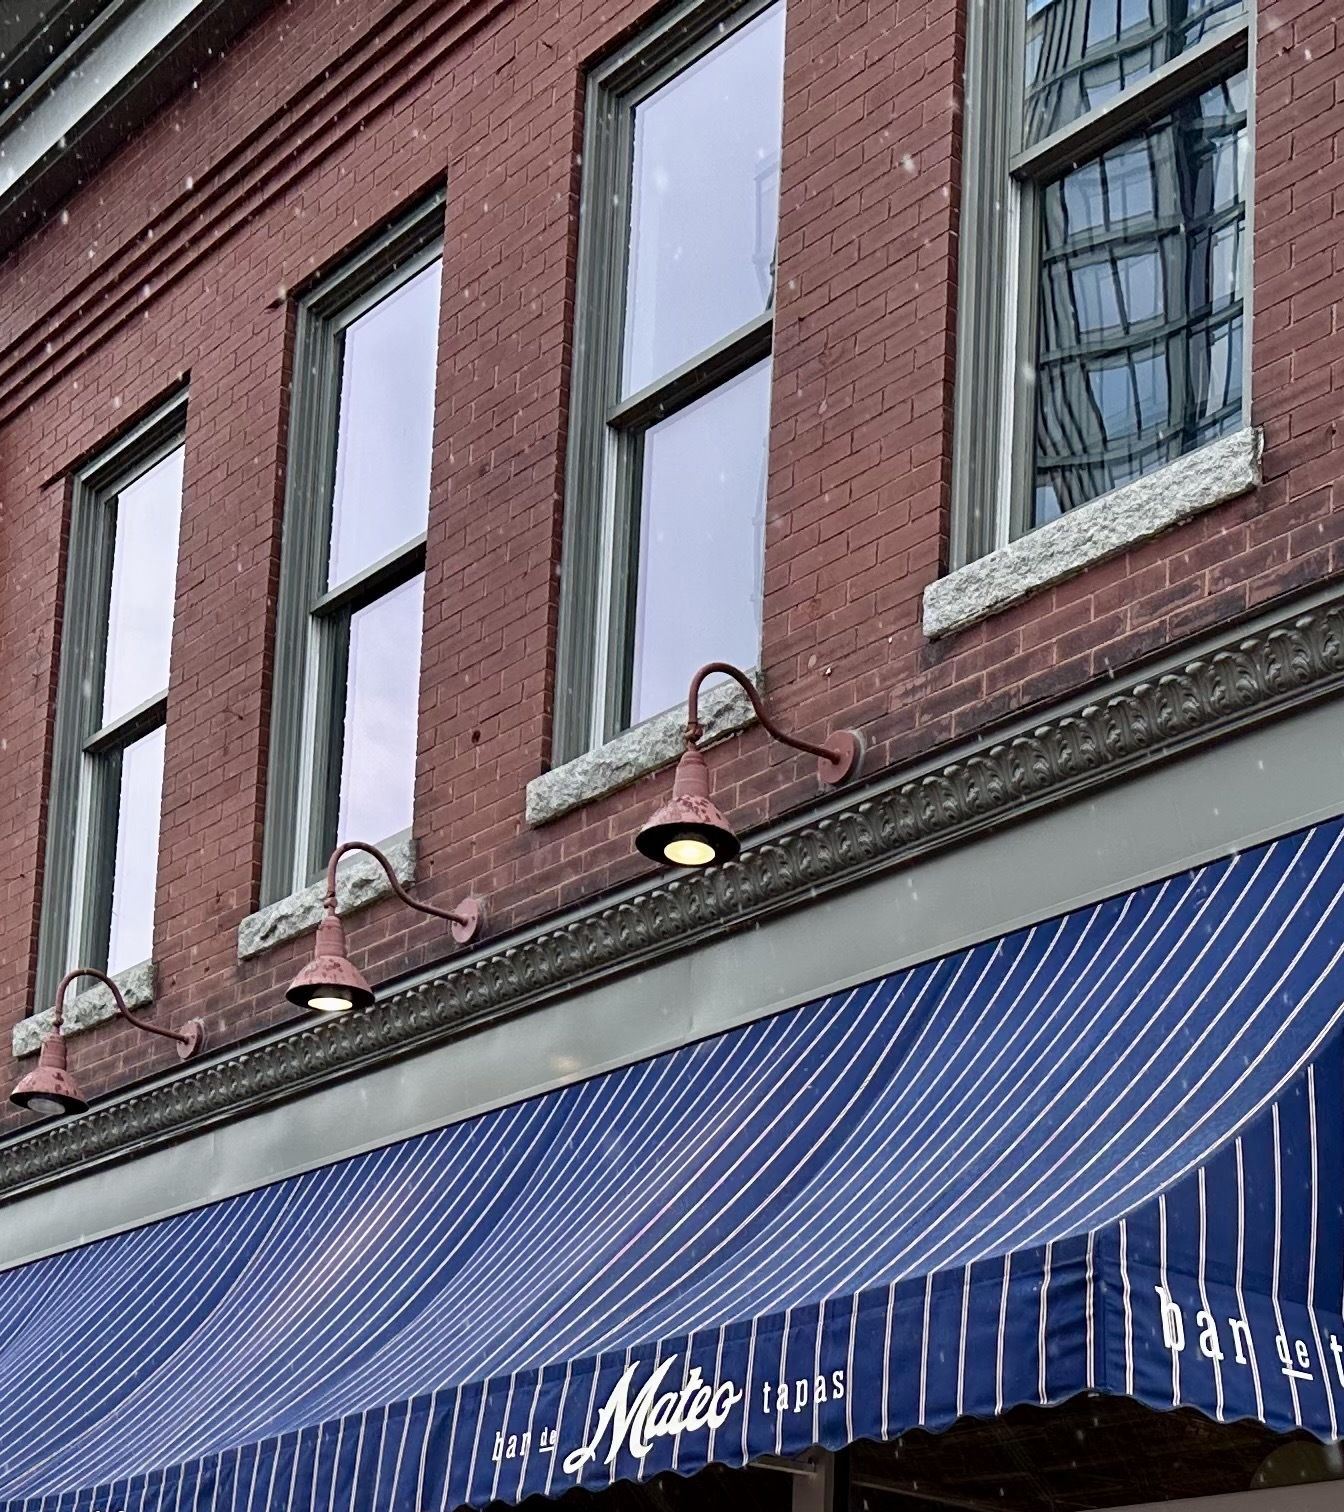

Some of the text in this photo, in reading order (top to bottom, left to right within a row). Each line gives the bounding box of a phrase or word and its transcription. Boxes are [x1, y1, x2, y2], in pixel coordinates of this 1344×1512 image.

[1154, 1285, 1250, 1364] bar
[1274, 1333, 1313, 1381] de
[491, 1431, 532, 1461] bar
[562, 1353, 743, 1474] Mateo
[762, 1370, 846, 1414] tapas
